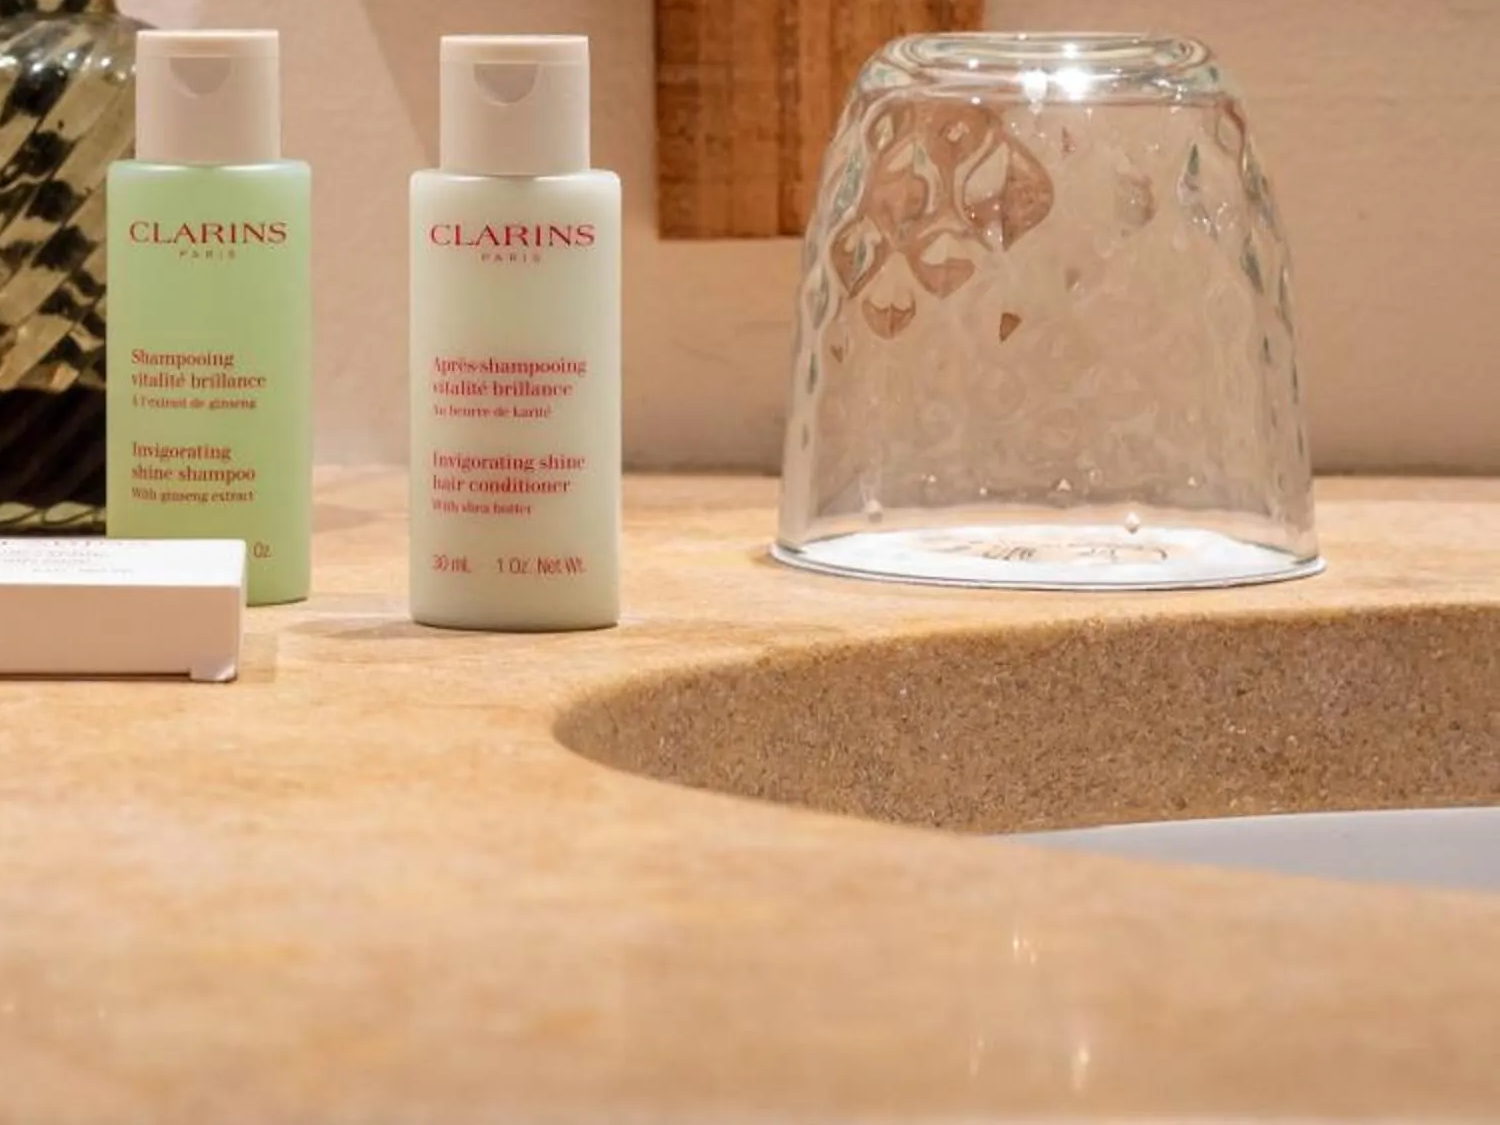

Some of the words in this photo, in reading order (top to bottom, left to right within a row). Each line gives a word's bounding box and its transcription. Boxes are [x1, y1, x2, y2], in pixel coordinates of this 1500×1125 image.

[129, 222, 288, 245] CLARINS
[430, 224, 596, 247] CLARINS
[179, 250, 236, 260] PARIS
[481, 254, 542, 263] PARIS
[131, 348, 235, 369] Shampooing
[132, 372, 185, 389] vitalité
[190, 372, 267, 390] brillance
[432, 380, 488, 397] vitalité
[492, 380, 574, 397] brillance
[132, 441, 232, 462] Invigorating
[433, 450, 536, 473] Invigorating
[540, 453, 586, 471] shine
[132, 465, 174, 481] shine
[178, 465, 256, 486] shampoo
[433, 474, 466, 493] hair
[469, 476, 571, 494] conditioner
[132, 486, 158, 501] With
[211, 490, 255, 503] extract
[432, 498, 460, 514] With
[537, 557, 562, 574] Net
